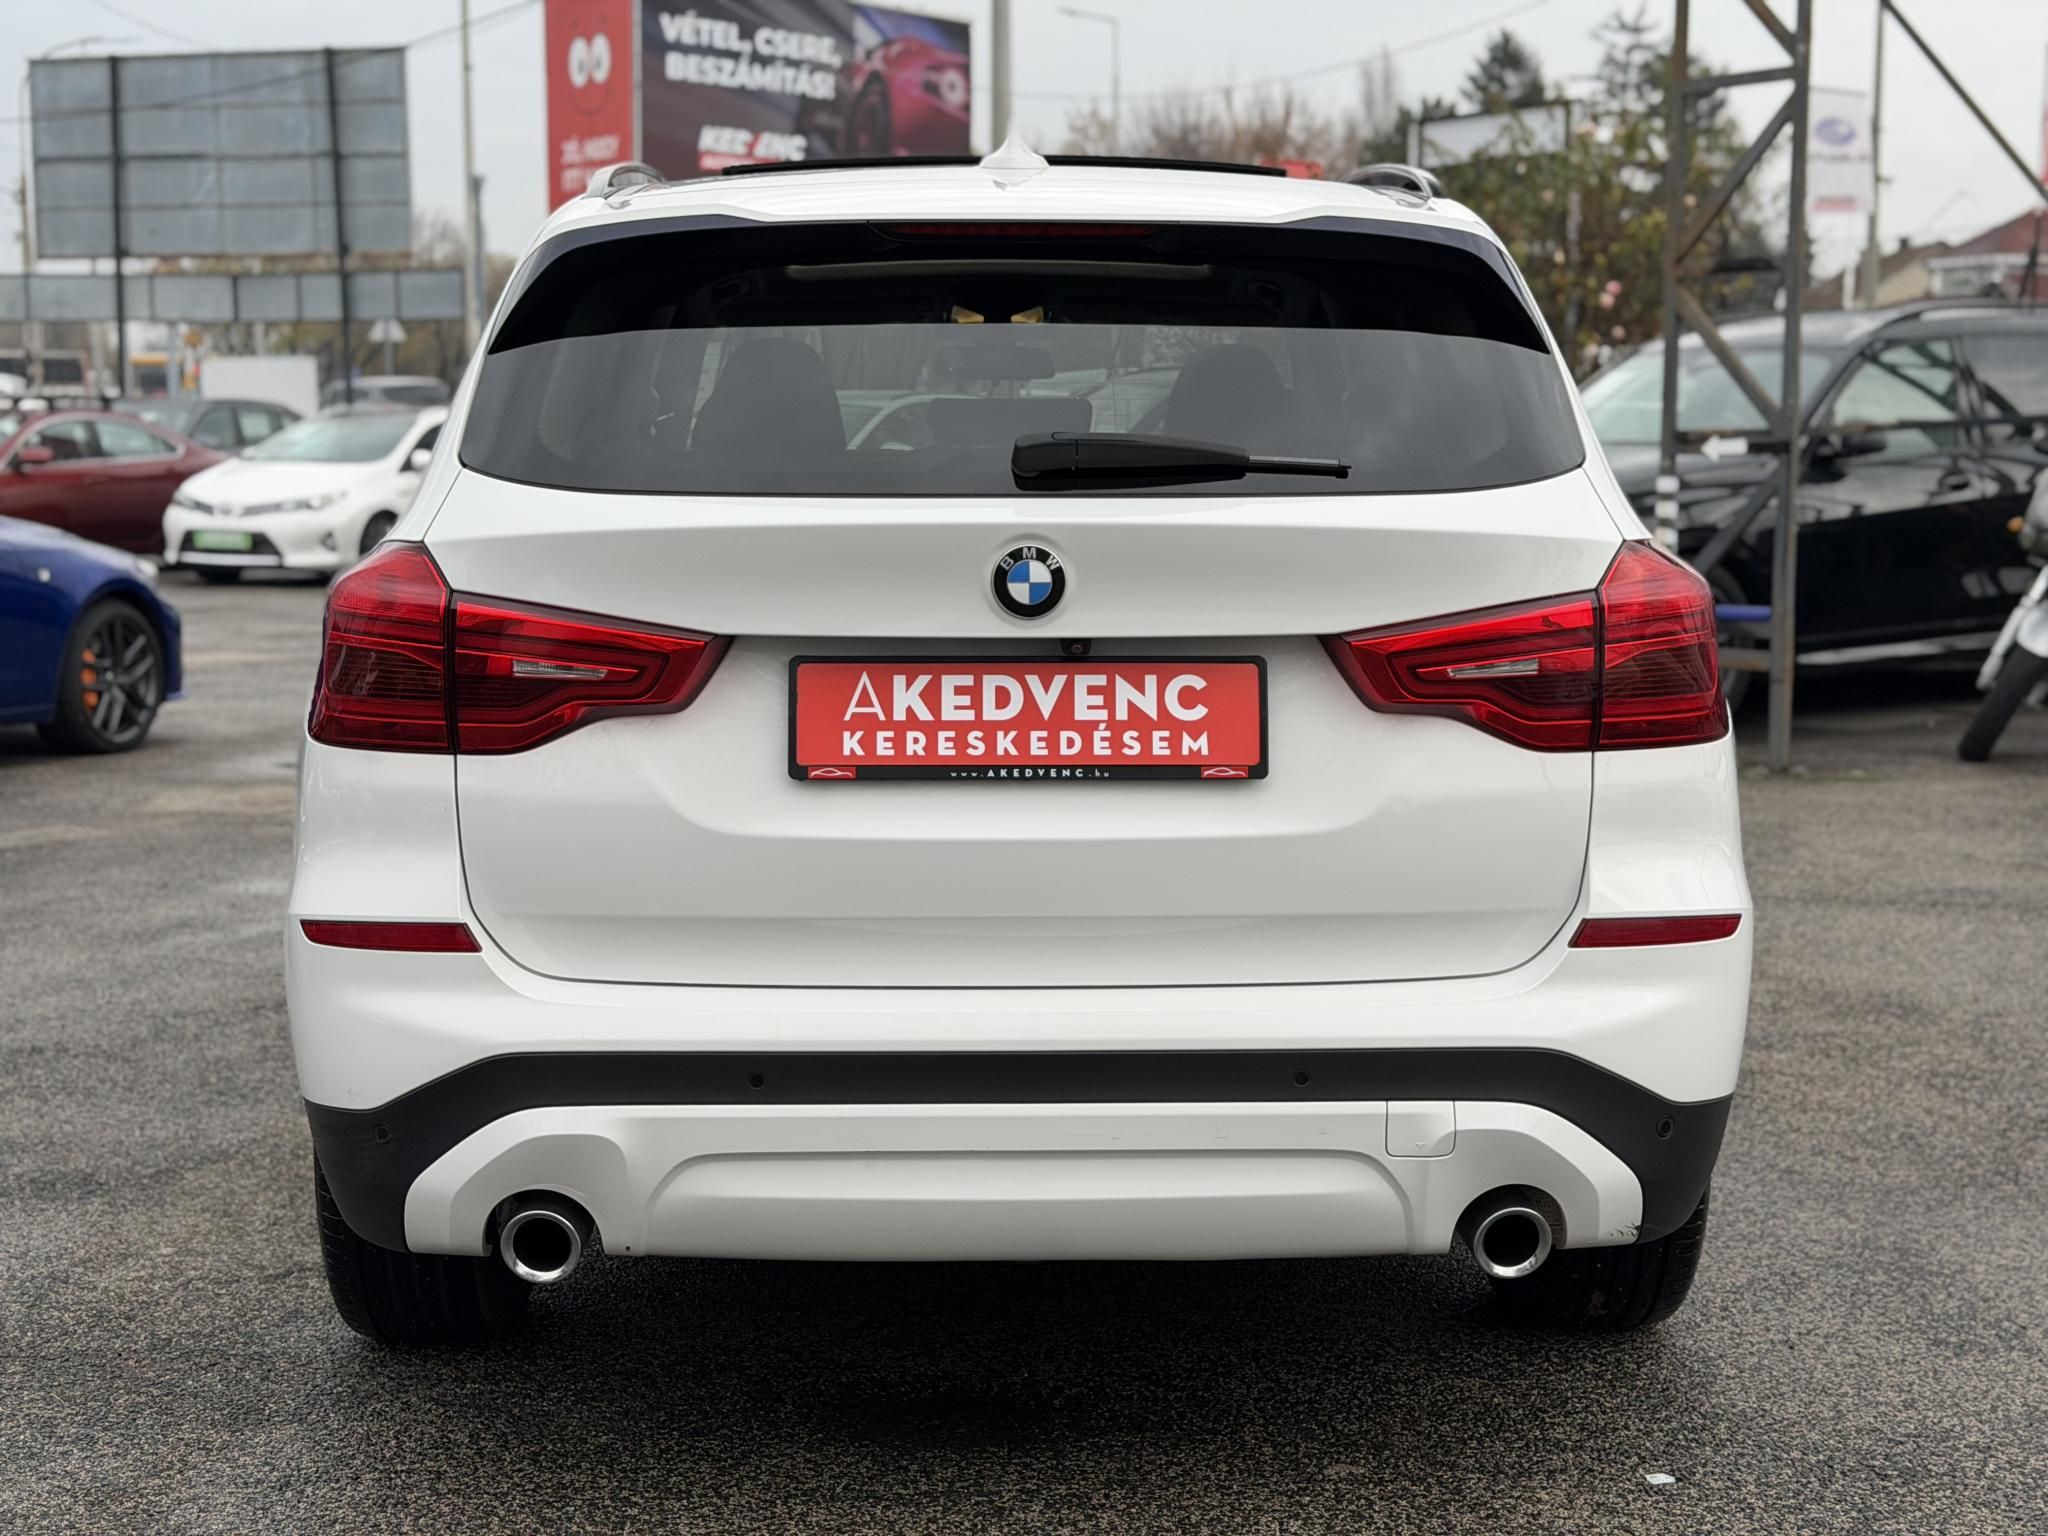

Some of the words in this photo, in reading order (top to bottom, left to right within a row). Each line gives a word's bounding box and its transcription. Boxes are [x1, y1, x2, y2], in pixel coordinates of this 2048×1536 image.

[658, 9, 753, 53] VÉTEL,
[754, 26, 843, 70] CSERE,
[1000, 547, 1060, 571] BMW
[842, 723, 1209, 757] KERESKEDÉSEM
[950, 768, 1110, 778] www.AKEDVENC.hu
